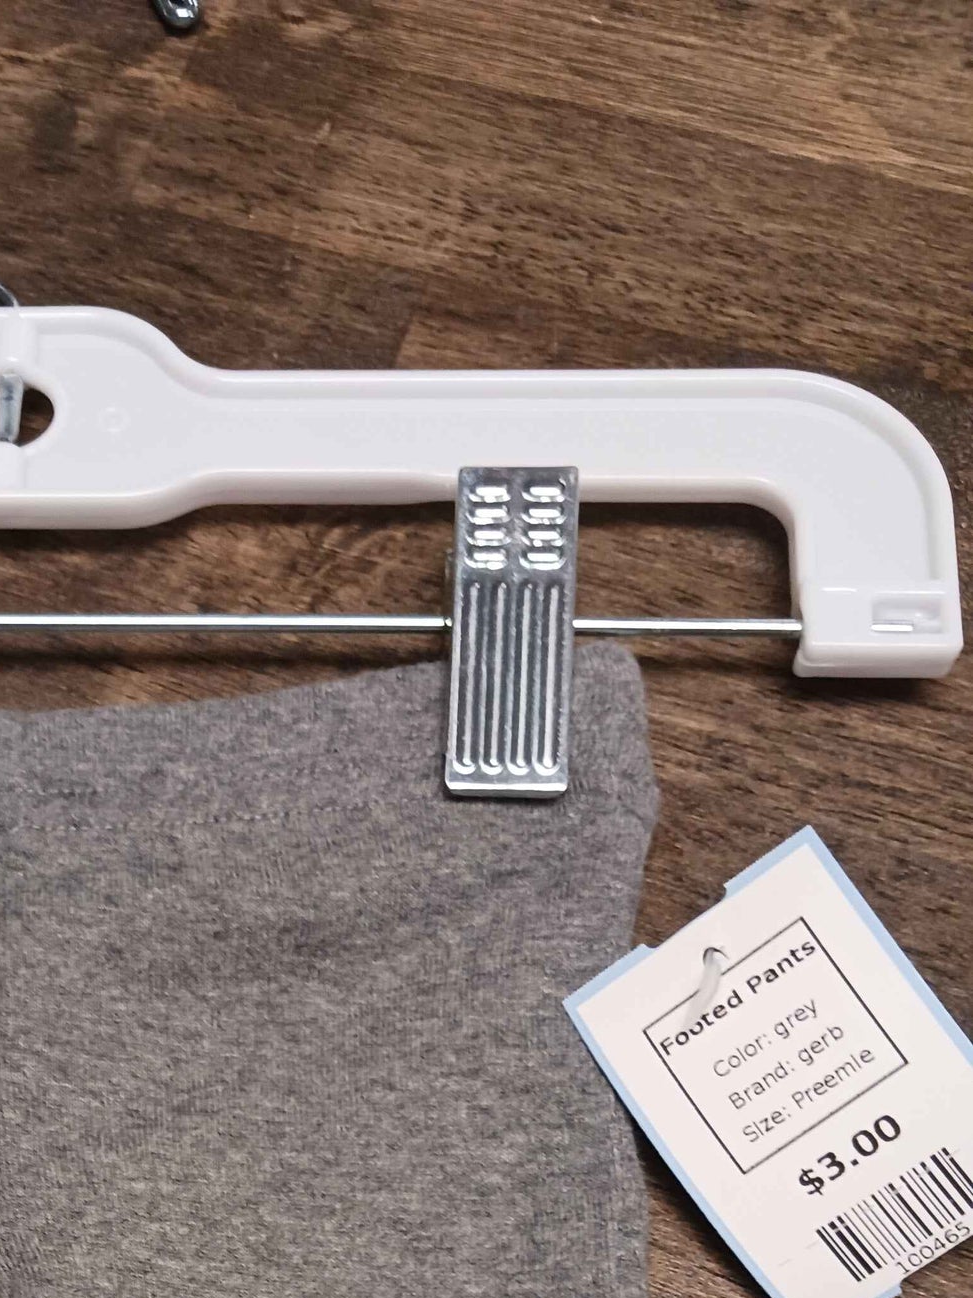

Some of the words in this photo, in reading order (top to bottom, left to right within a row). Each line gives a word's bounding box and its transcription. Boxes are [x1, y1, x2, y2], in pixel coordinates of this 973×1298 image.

[659, 989, 744, 1056] Footed
[746, 941, 816, 994] Pants
[713, 1033, 772, 1077] Color:
[774, 998, 818, 1039] grey
[728, 1060, 795, 1110] Brand:
[797, 1025, 845, 1066] gerb
[742, 1106, 792, 1143] Size:
[791, 1048, 876, 1109] Preemie
[798, 1114, 901, 1196] $3.00
[894, 1221, 971, 1275] 100465
